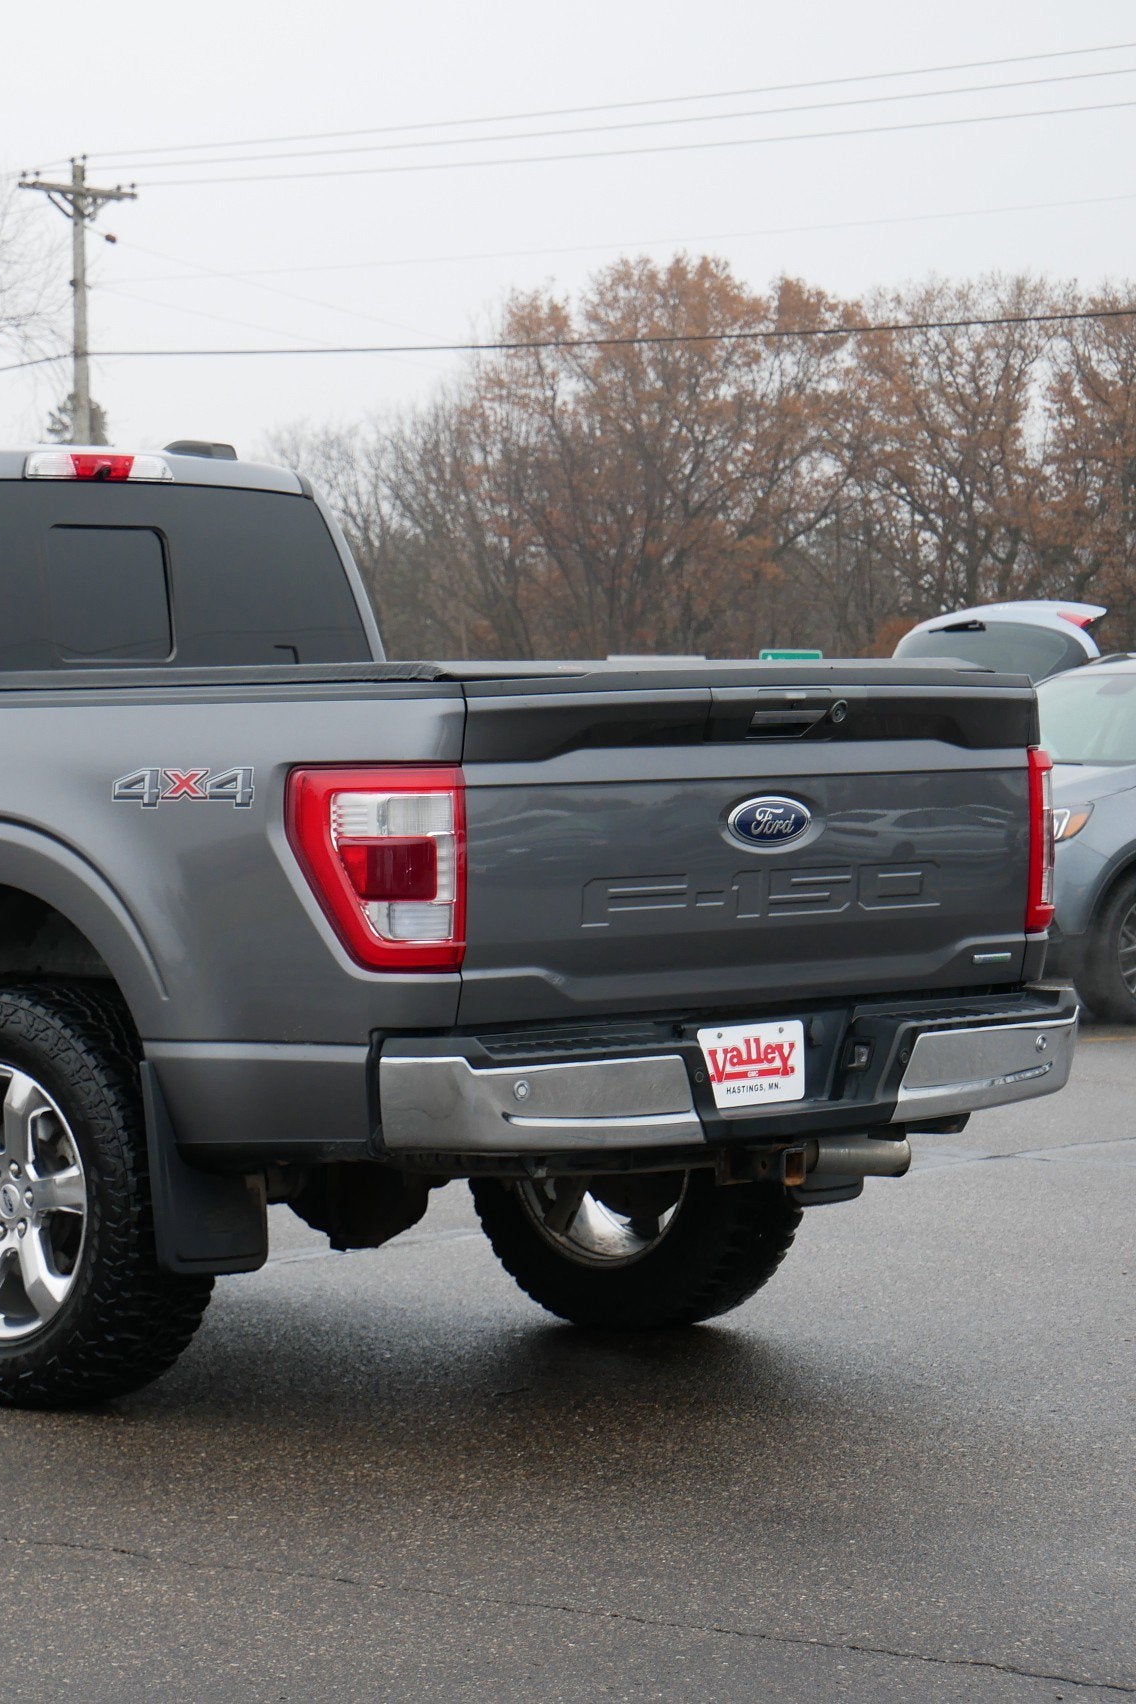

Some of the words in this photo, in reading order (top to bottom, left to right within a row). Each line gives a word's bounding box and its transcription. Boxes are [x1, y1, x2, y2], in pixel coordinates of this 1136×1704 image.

[751, 807, 795, 835] Ford
[581, 861, 941, 927] F-150
[707, 1036, 795, 1083] Valley
[726, 1084, 766, 1094] HASTINGS,
